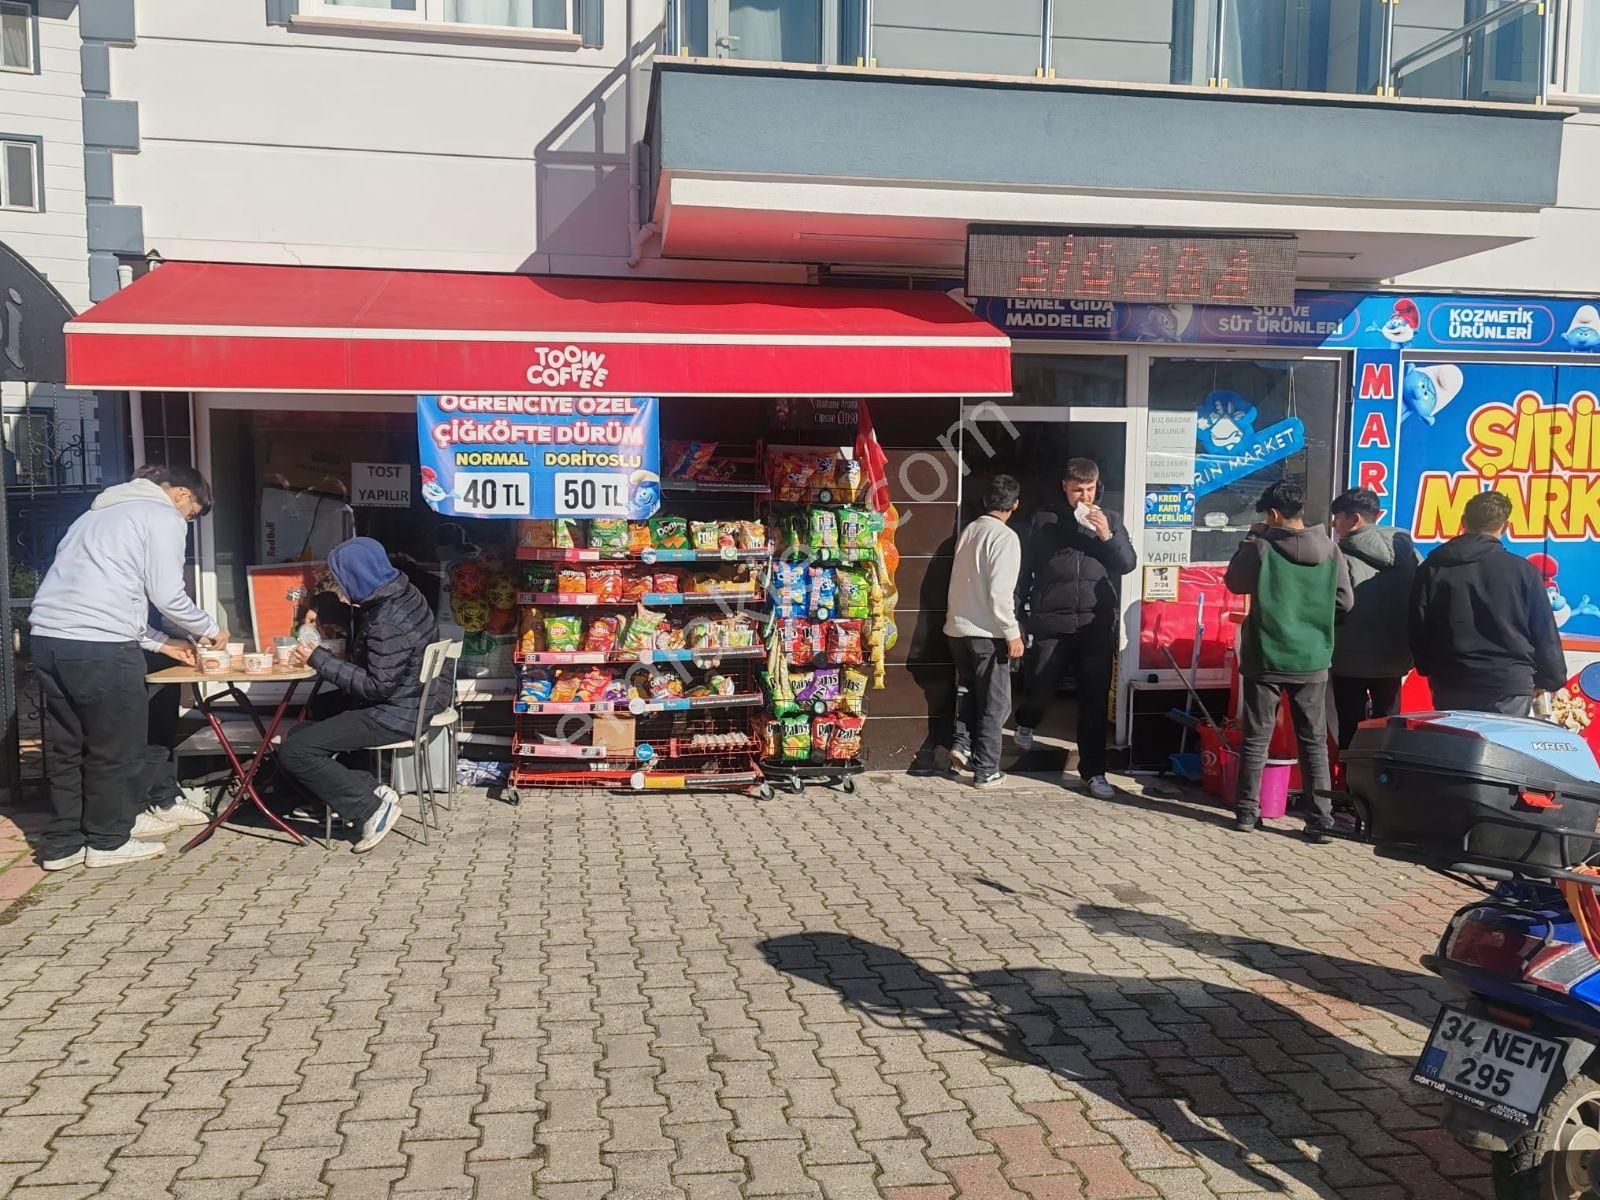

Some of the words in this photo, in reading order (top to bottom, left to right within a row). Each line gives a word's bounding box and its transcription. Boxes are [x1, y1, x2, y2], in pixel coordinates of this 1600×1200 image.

[1004, 298, 1065, 311] TEMEL
[1070, 300, 1115, 312] GIDA
[1291, 306, 1310, 317] VE
[1005, 311, 1113, 329] MADDELERİ
[1217, 315, 1253, 332] SÜT
[1256, 315, 1344, 335] ÜRÜNLERİ
[1449, 307, 1534, 325] KOZMETİK
[1448, 322, 1533, 340] ÜRÜNLERİ
[534, 345, 606, 370] TOOW
[526, 363, 609, 389] COFFEE
[433, 419, 552, 448] ÇİĞKÖFTE
[556, 421, 644, 446] DÜRÜM
[1464, 392, 1600, 479] ŞİRİ
[1228, 427, 1295, 470] MARKET
[455, 452, 529, 467] NORMAL
[544, 450, 642, 468] DORİTOSLU
[367, 465, 402, 478] TOST
[358, 488, 409, 502] YAPILIR
[463, 479, 497, 510] 40
[503, 484, 525, 507] TL
[563, 479, 596, 510] 50
[602, 484, 624, 508] TL
[1158, 492, 1182, 503] KREDİ
[1158, 504, 1181, 512] KARTI
[1146, 512, 1193, 525] GEÇERLİDİR
[1155, 531, 1185, 542] TOST
[1147, 552, 1188, 563] YAPILIR
[1532, 741, 1578, 751] KRAL
[1441, 1016, 1477, 1048] 34
[1482, 1028, 1557, 1074] NEM
[1426, 1064, 1439, 1076] TR
[1455, 1057, 1514, 1097] 295
